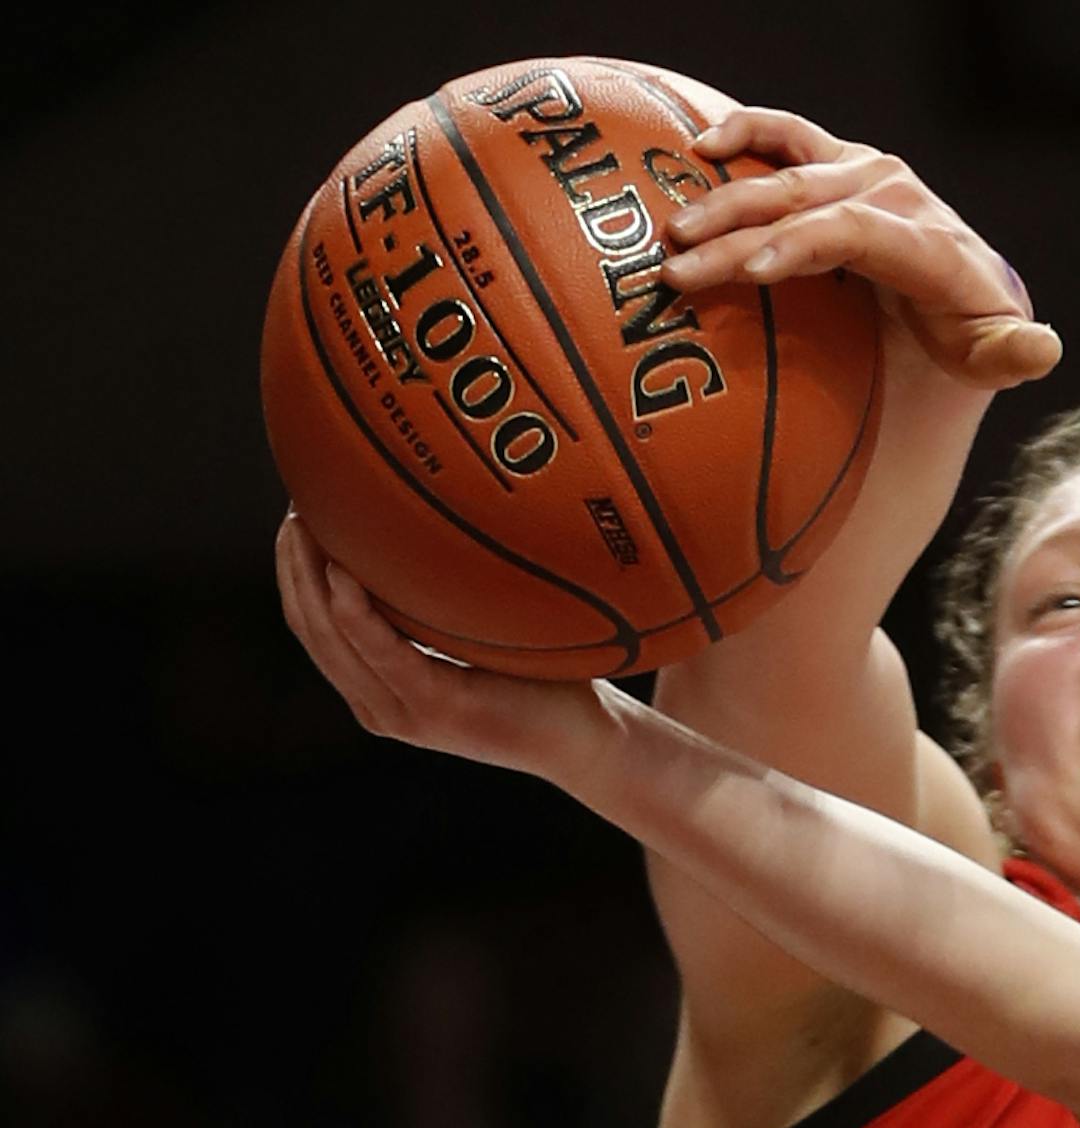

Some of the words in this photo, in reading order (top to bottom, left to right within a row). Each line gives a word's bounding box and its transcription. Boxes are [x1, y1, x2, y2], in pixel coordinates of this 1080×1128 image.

[344, 258, 432, 386] LEGACY
[452, 230, 495, 290] 28.5
[312, 241, 335, 288] DEEP
[329, 292, 382, 389] CHANNEL
[380, 392, 443, 476] DESIGN
